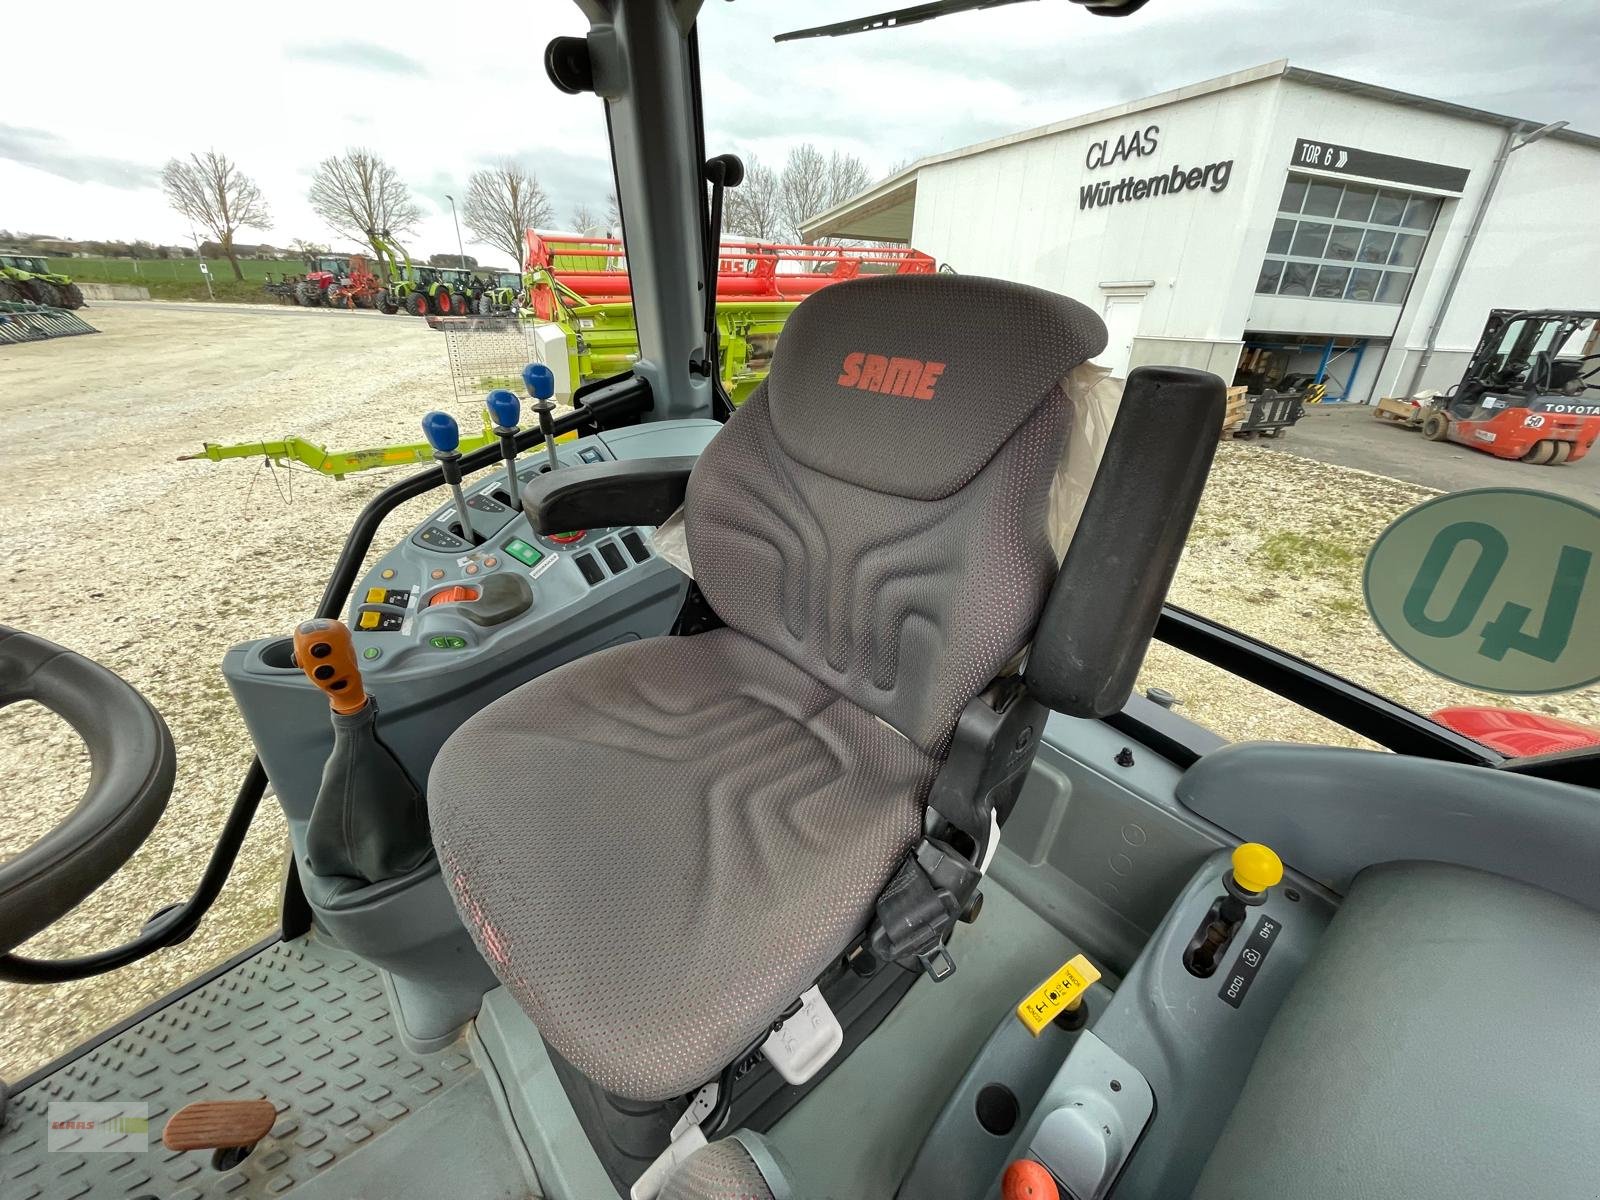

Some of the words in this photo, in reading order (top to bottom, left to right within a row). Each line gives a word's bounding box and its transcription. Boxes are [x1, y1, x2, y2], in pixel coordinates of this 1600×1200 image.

[1086, 125, 1160, 170] CLAAS
[1300, 143, 1321, 164] TOR
[1324, 148, 1333, 166] 6
[1079, 160, 1234, 210] Württemberg
[837, 351, 946, 400] SAME
[1545, 403, 1600, 415] TOYOTA
[1526, 415, 1542, 427] 50
[1260, 922, 1274, 939] 540
[1227, 975, 1244, 998] 1000
